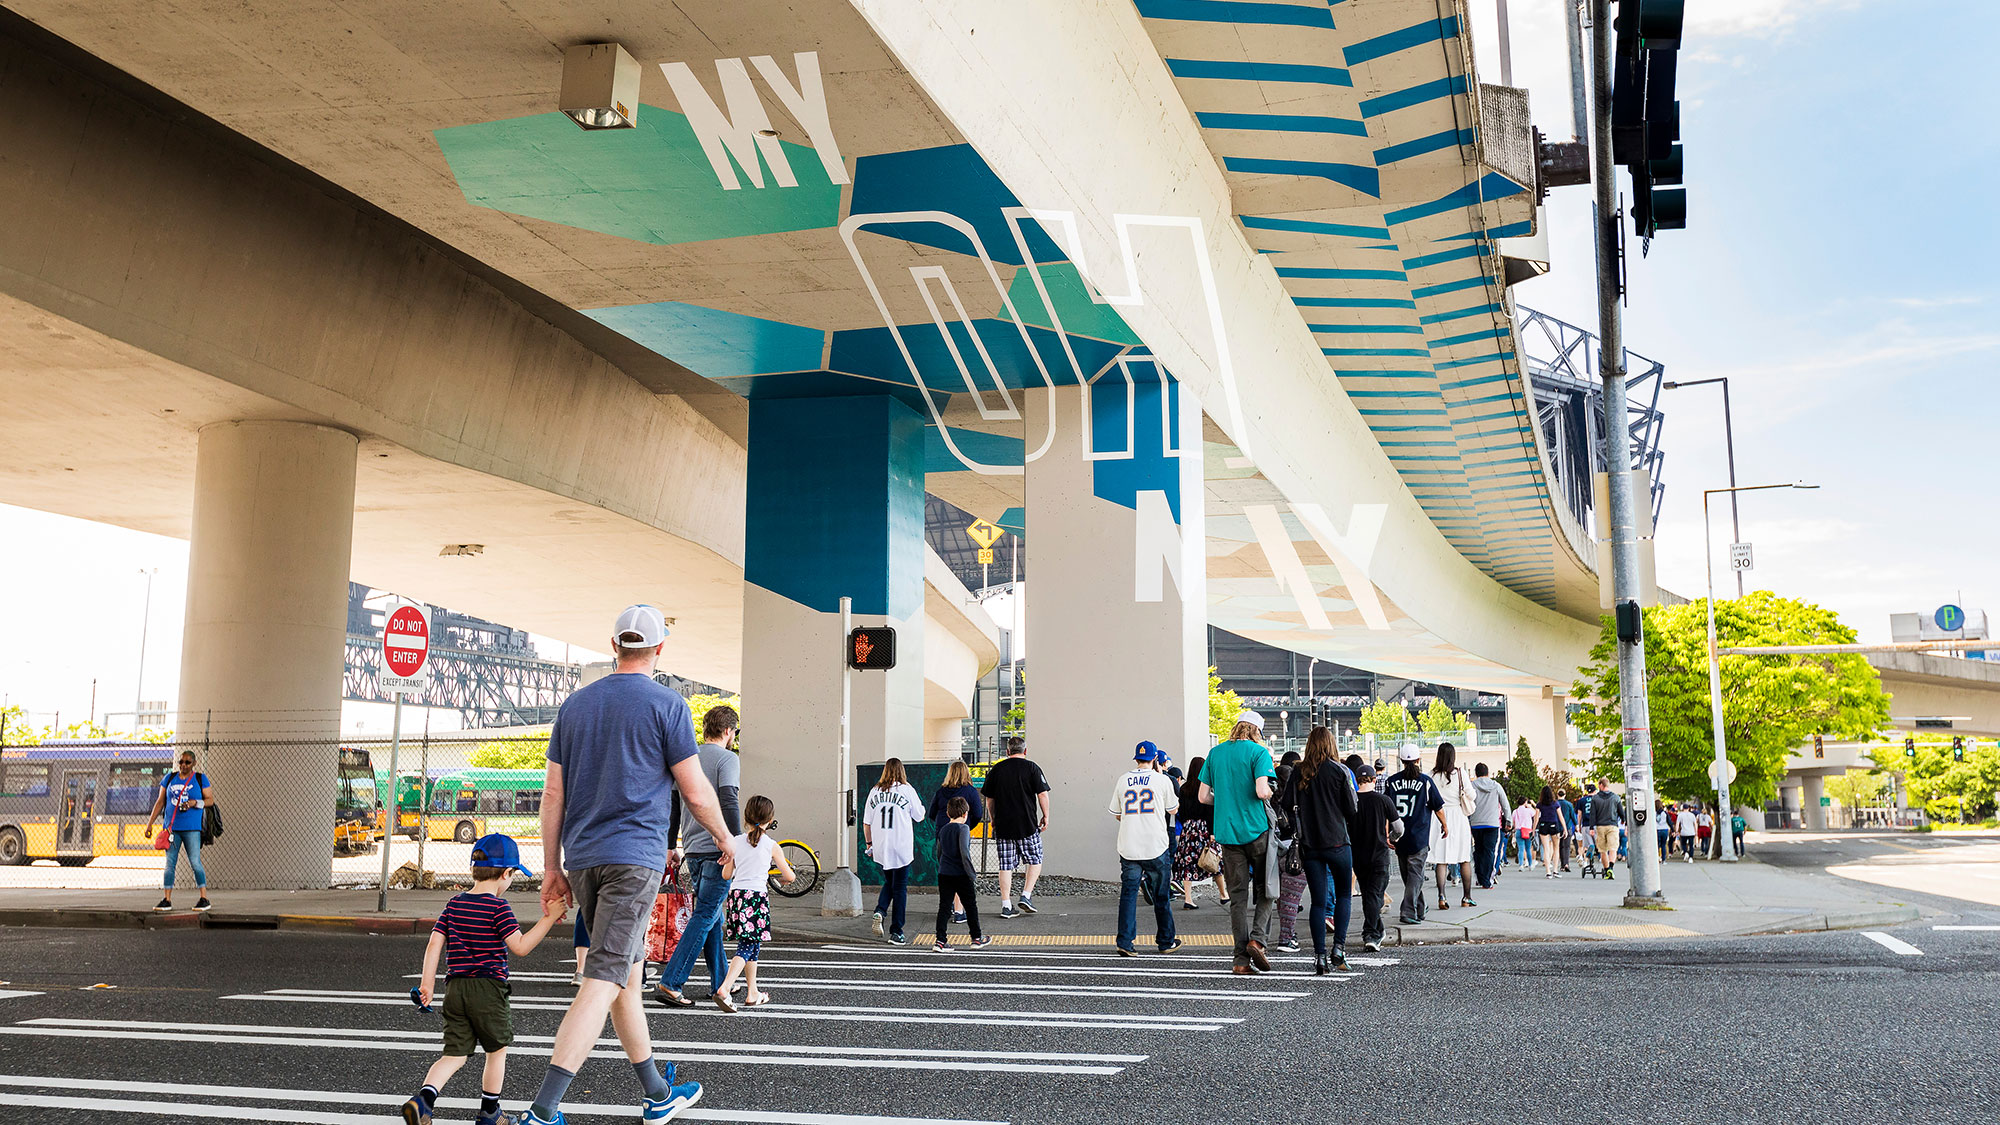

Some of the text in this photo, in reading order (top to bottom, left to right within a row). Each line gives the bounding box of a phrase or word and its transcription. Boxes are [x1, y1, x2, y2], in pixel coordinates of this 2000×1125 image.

[658, 51, 851, 190] MY
[839, 206, 1255, 475] OH
[980, 551, 992, 559] 30
[1734, 558, 1751, 568] 30
[393, 618, 423, 633] DO NOT
[1943, 606, 1955, 629] P
[392, 651, 418, 664] ENTER
[382, 677, 424, 689] EXCEPT TRANSIT
[1391, 779, 1424, 792] ICHIRO
[869, 791, 910, 810] MARTINEZ
[1124, 788, 1155, 815] 22
[1396, 794, 1417, 818] 51
[880, 805, 894, 829] 11
